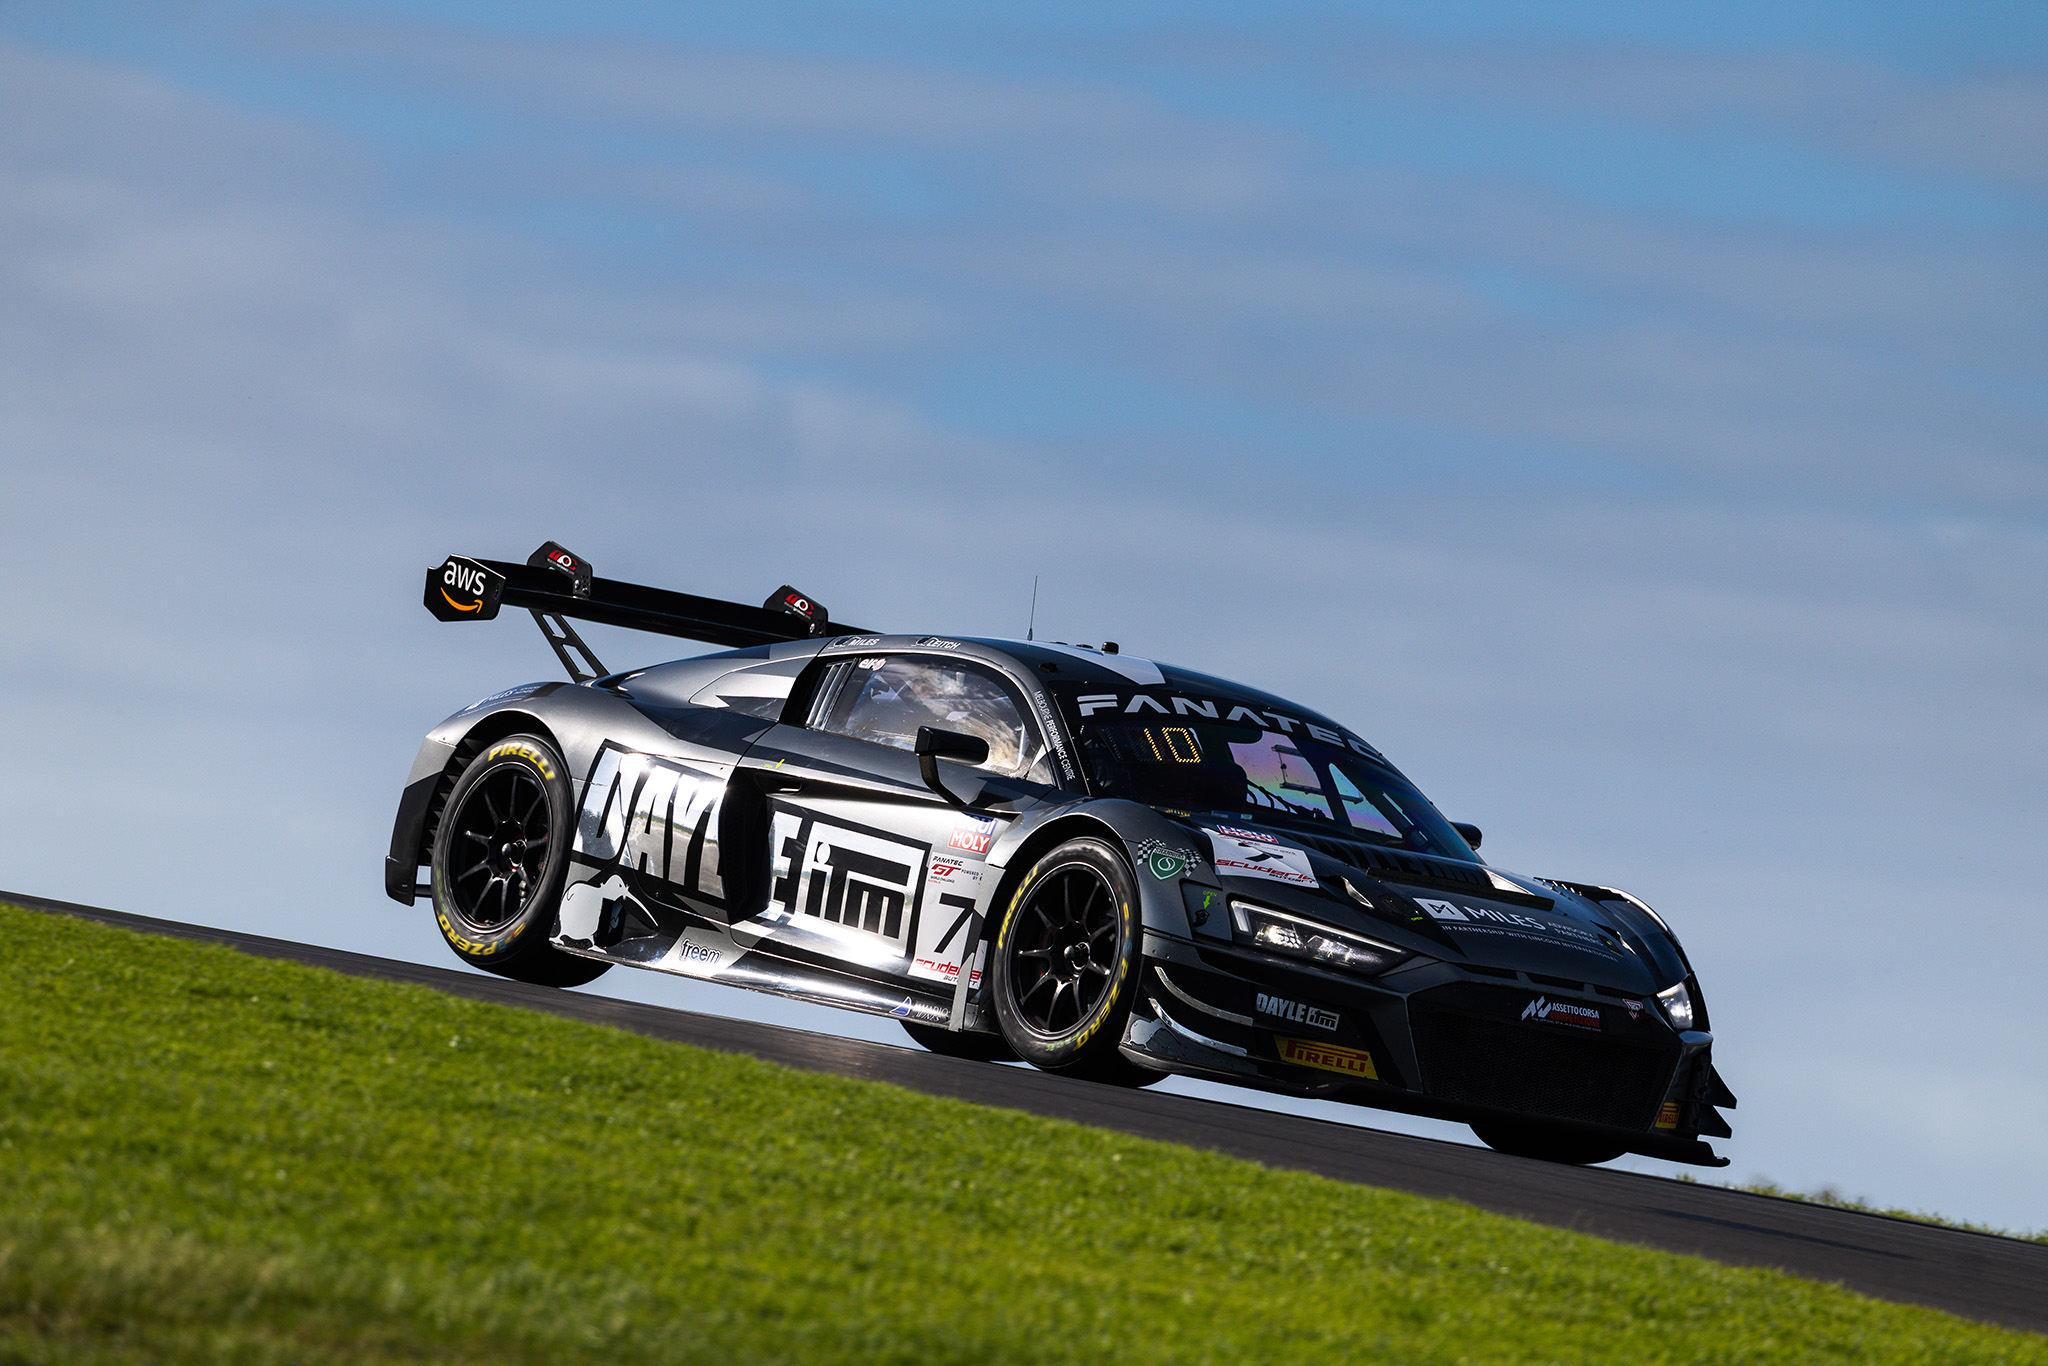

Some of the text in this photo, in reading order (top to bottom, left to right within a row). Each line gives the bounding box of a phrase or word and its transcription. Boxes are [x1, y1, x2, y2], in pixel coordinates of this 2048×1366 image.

[443, 561, 487, 596] aws
[848, 638, 880, 647] MILES
[926, 640, 961, 650] LEITCH
[1034, 690, 1076, 781] MELBOURNE PERFORMANCE CENTRE
[1077, 694, 1388, 766] FANATEC
[1143, 727, 1201, 763] 10
[488, 742, 556, 781] PIRELLI
[950, 830, 991, 852] MOLY
[932, 855, 964, 866] FANATEC
[934, 892, 977, 954] 7
[998, 865, 1039, 950] PIRELLI
[1463, 905, 1546, 930] MILES
[681, 939, 721, 964] freem
[1453, 926, 1505, 935] PARTNERSHIP
[1506, 931, 1528, 939] WITH
[1528, 934, 1561, 946] LINCOLN
[1561, 941, 1619, 962] INTERNATIONAL
[1256, 992, 1307, 1022] DAYLE
[1550, 1010, 1600, 1028] COMPETIZIONE
[1552, 1002, 1599, 1019] ASSETTO CORSA
[1285, 1039, 1369, 1073] PIRELLI
